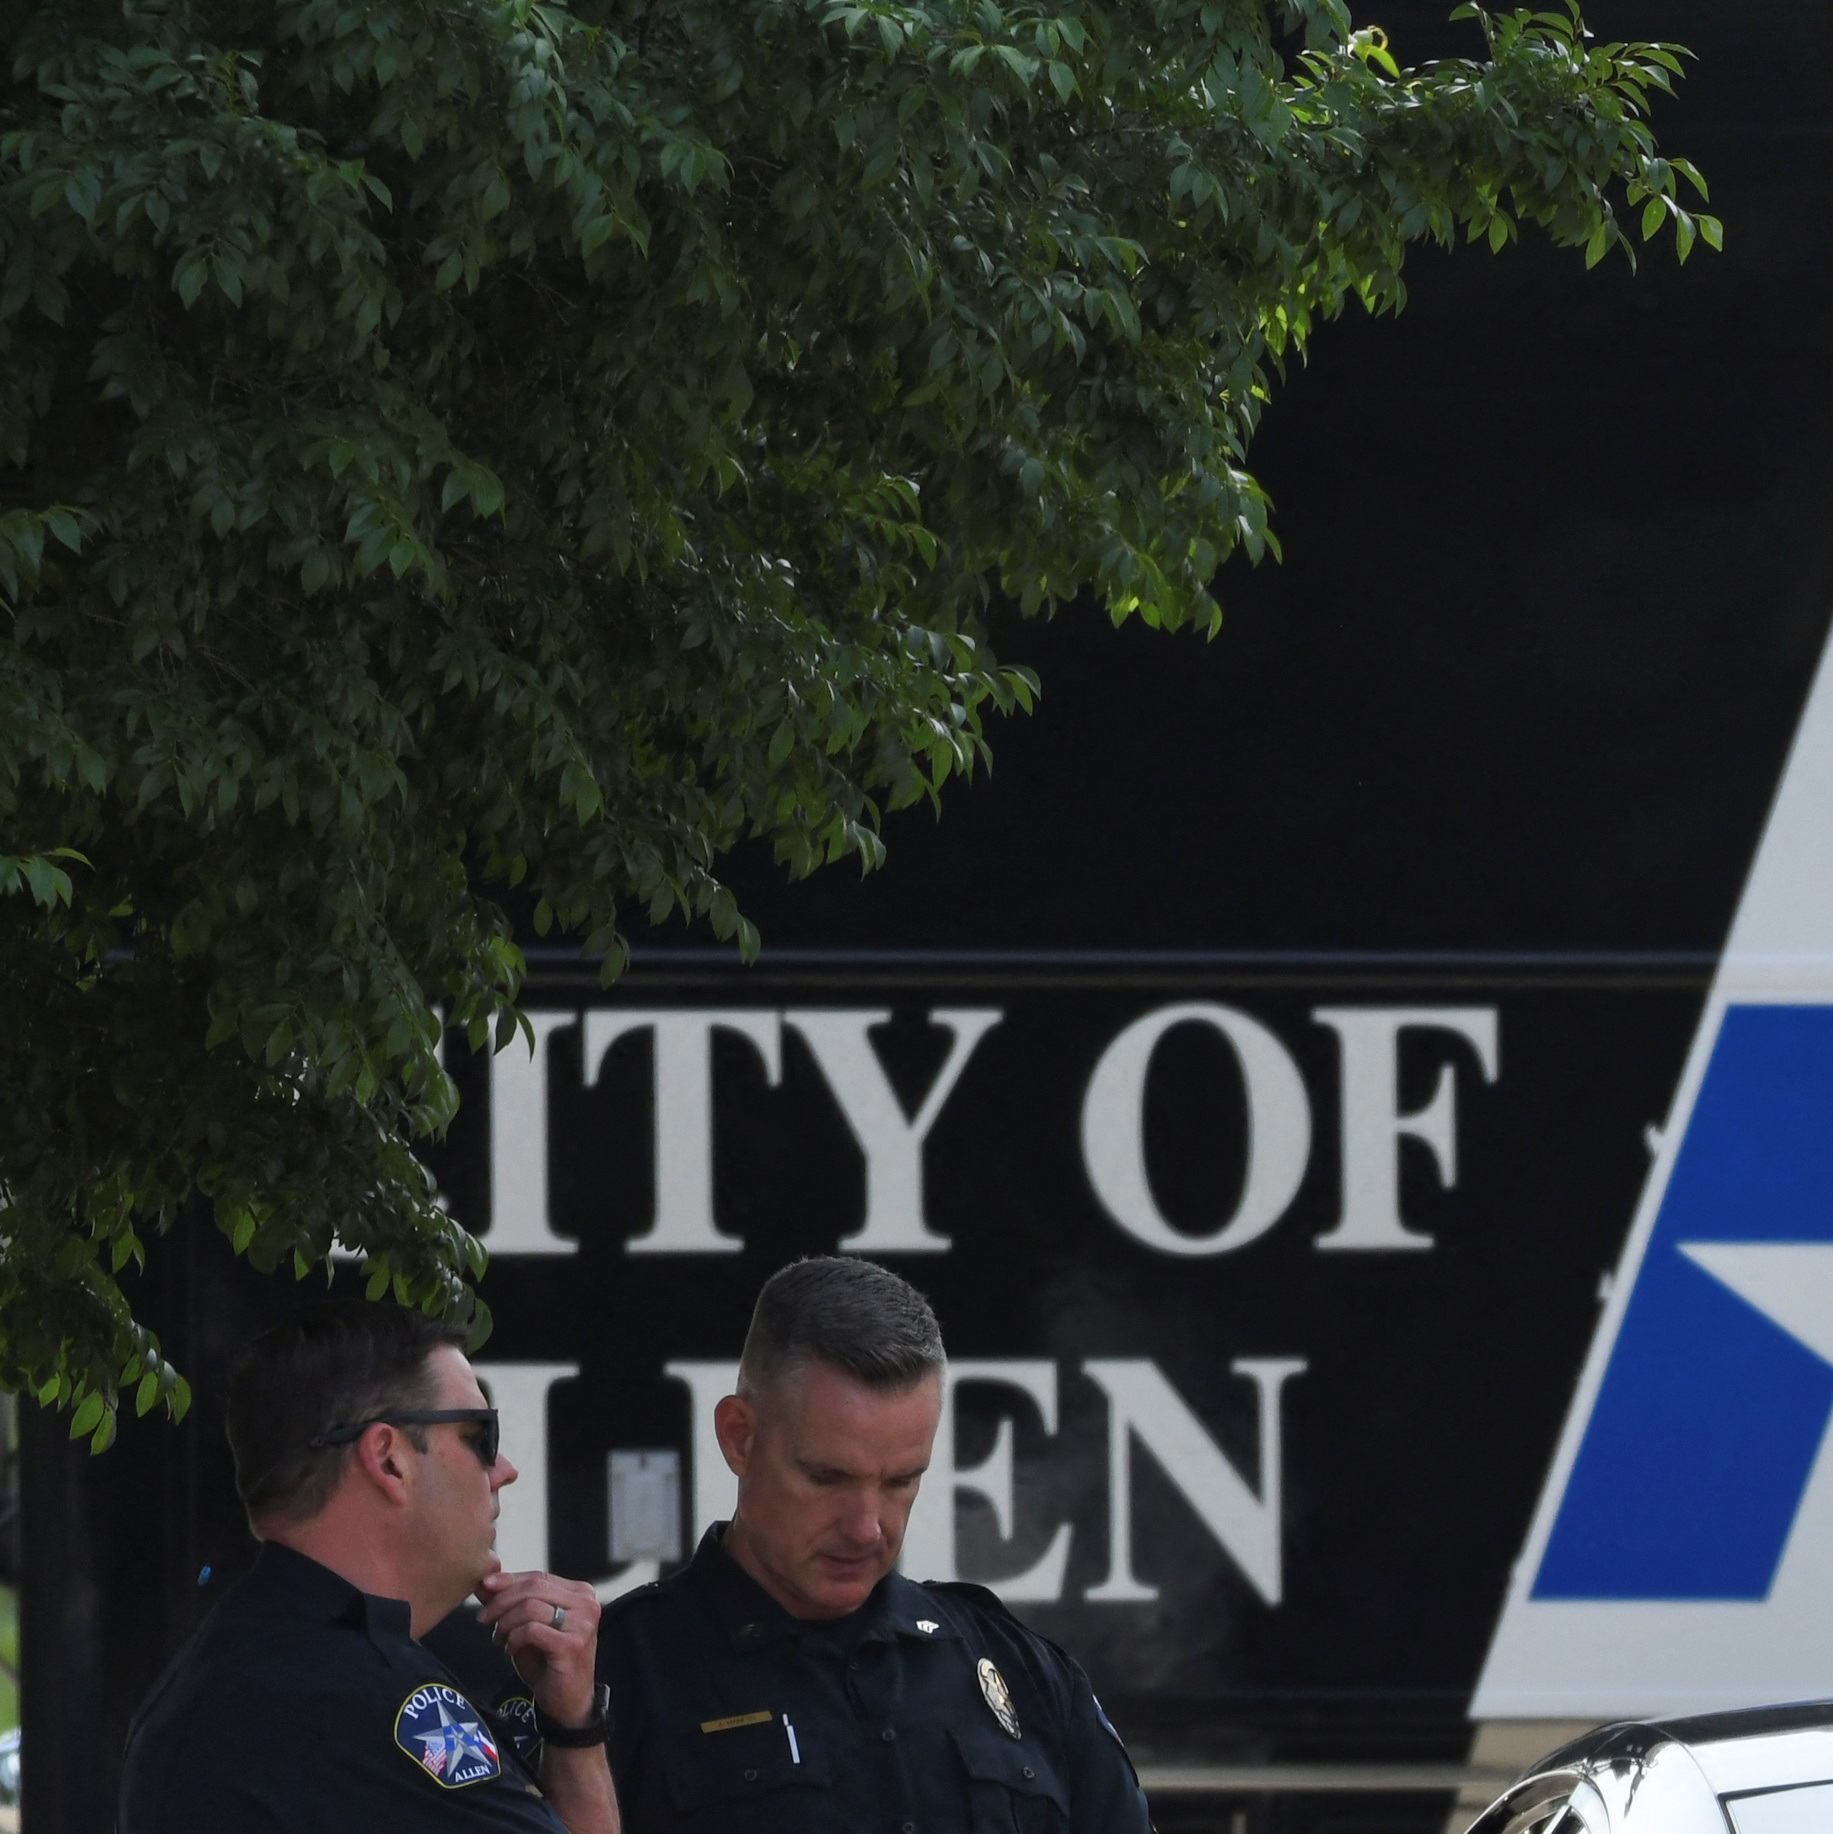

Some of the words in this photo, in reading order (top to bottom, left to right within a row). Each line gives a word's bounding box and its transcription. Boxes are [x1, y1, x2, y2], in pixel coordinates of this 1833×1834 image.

[328, 1003, 1003, 1258] ITY
[1080, 1001, 1499, 1257] OF
[404, 1686, 466, 1720] POLICE
[497, 1700, 534, 1724] LICE
[455, 1764, 491, 1783] ALLEN
